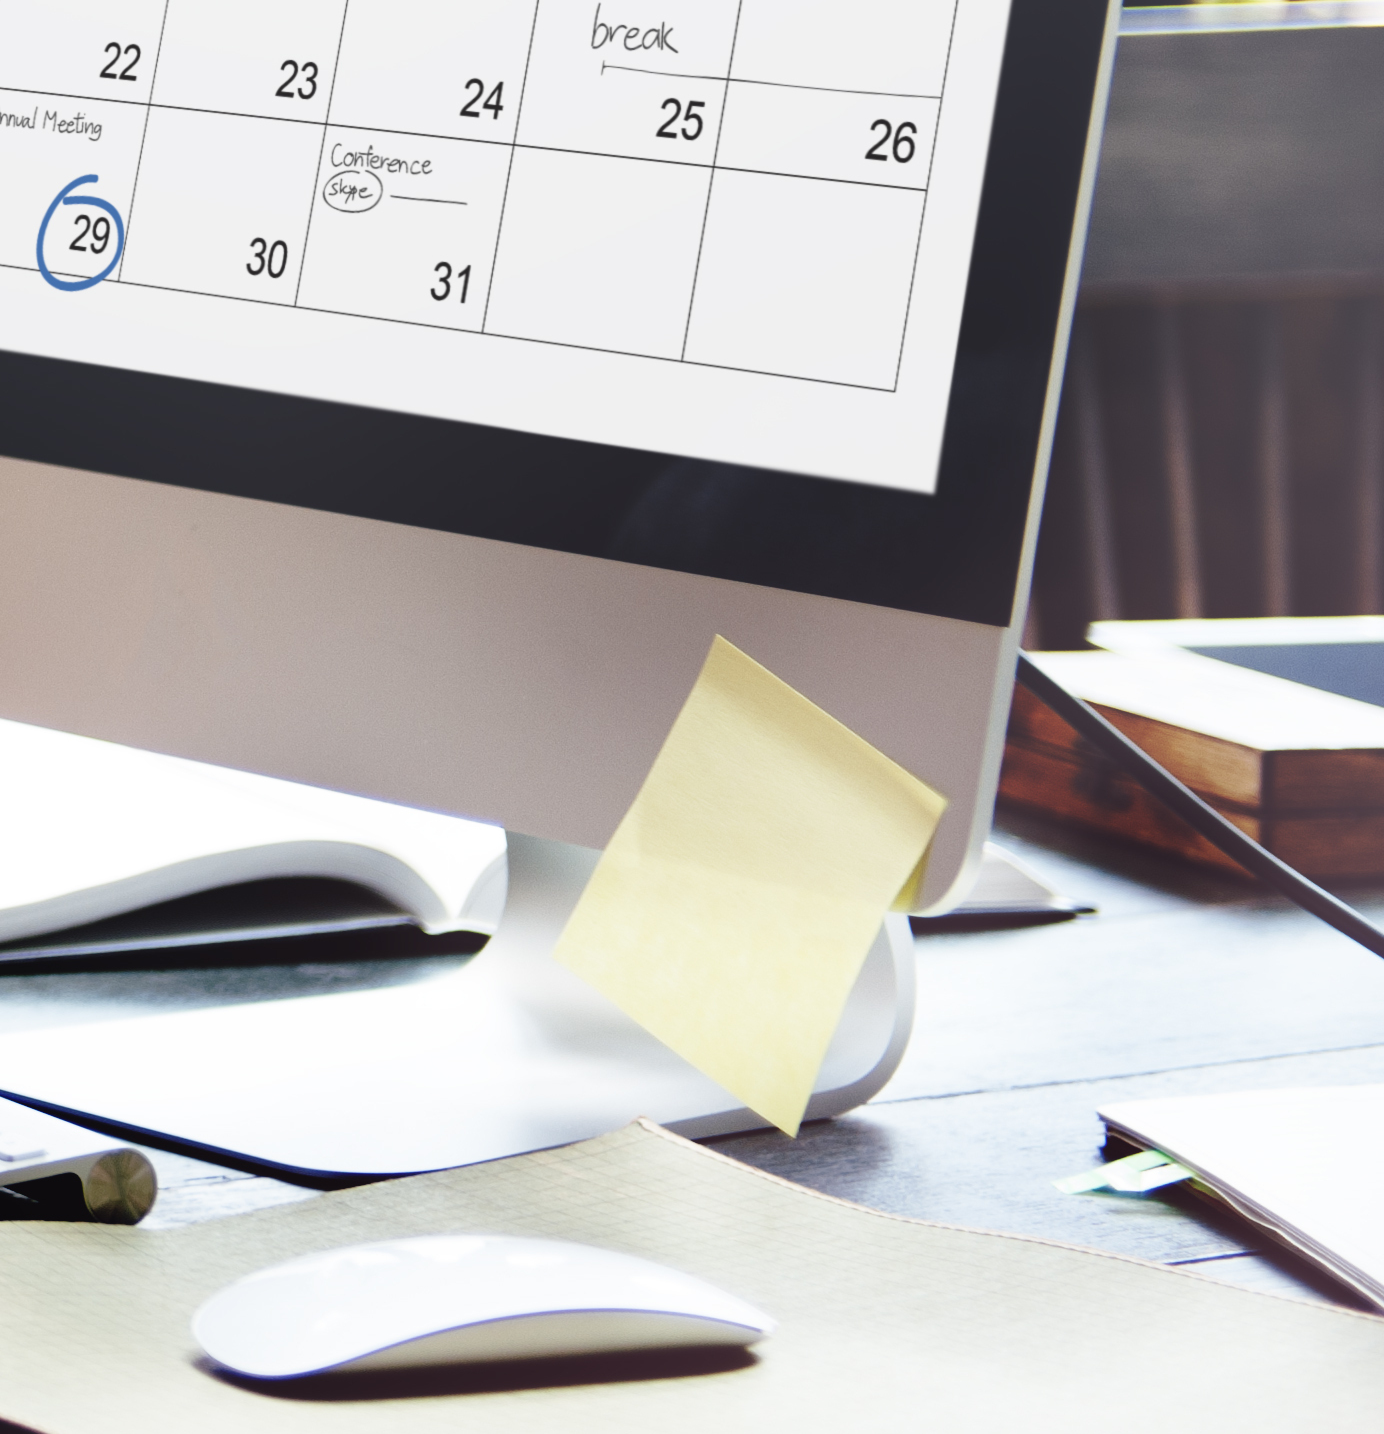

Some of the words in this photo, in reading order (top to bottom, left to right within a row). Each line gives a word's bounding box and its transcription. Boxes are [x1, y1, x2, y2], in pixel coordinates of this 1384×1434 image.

[590, 2, 679, 54] break
[99, 41, 141, 82] 22
[275, 59, 319, 100] 23
[459, 78, 504, 120] 24
[656, 97, 706, 141] 25
[43, 109, 103, 141] Meeting
[864, 118, 917, 164] 26
[331, 143, 433, 175] Conference
[69, 214, 111, 254] 29
[246, 237, 288, 279] 30
[430, 261, 471, 304] 31
